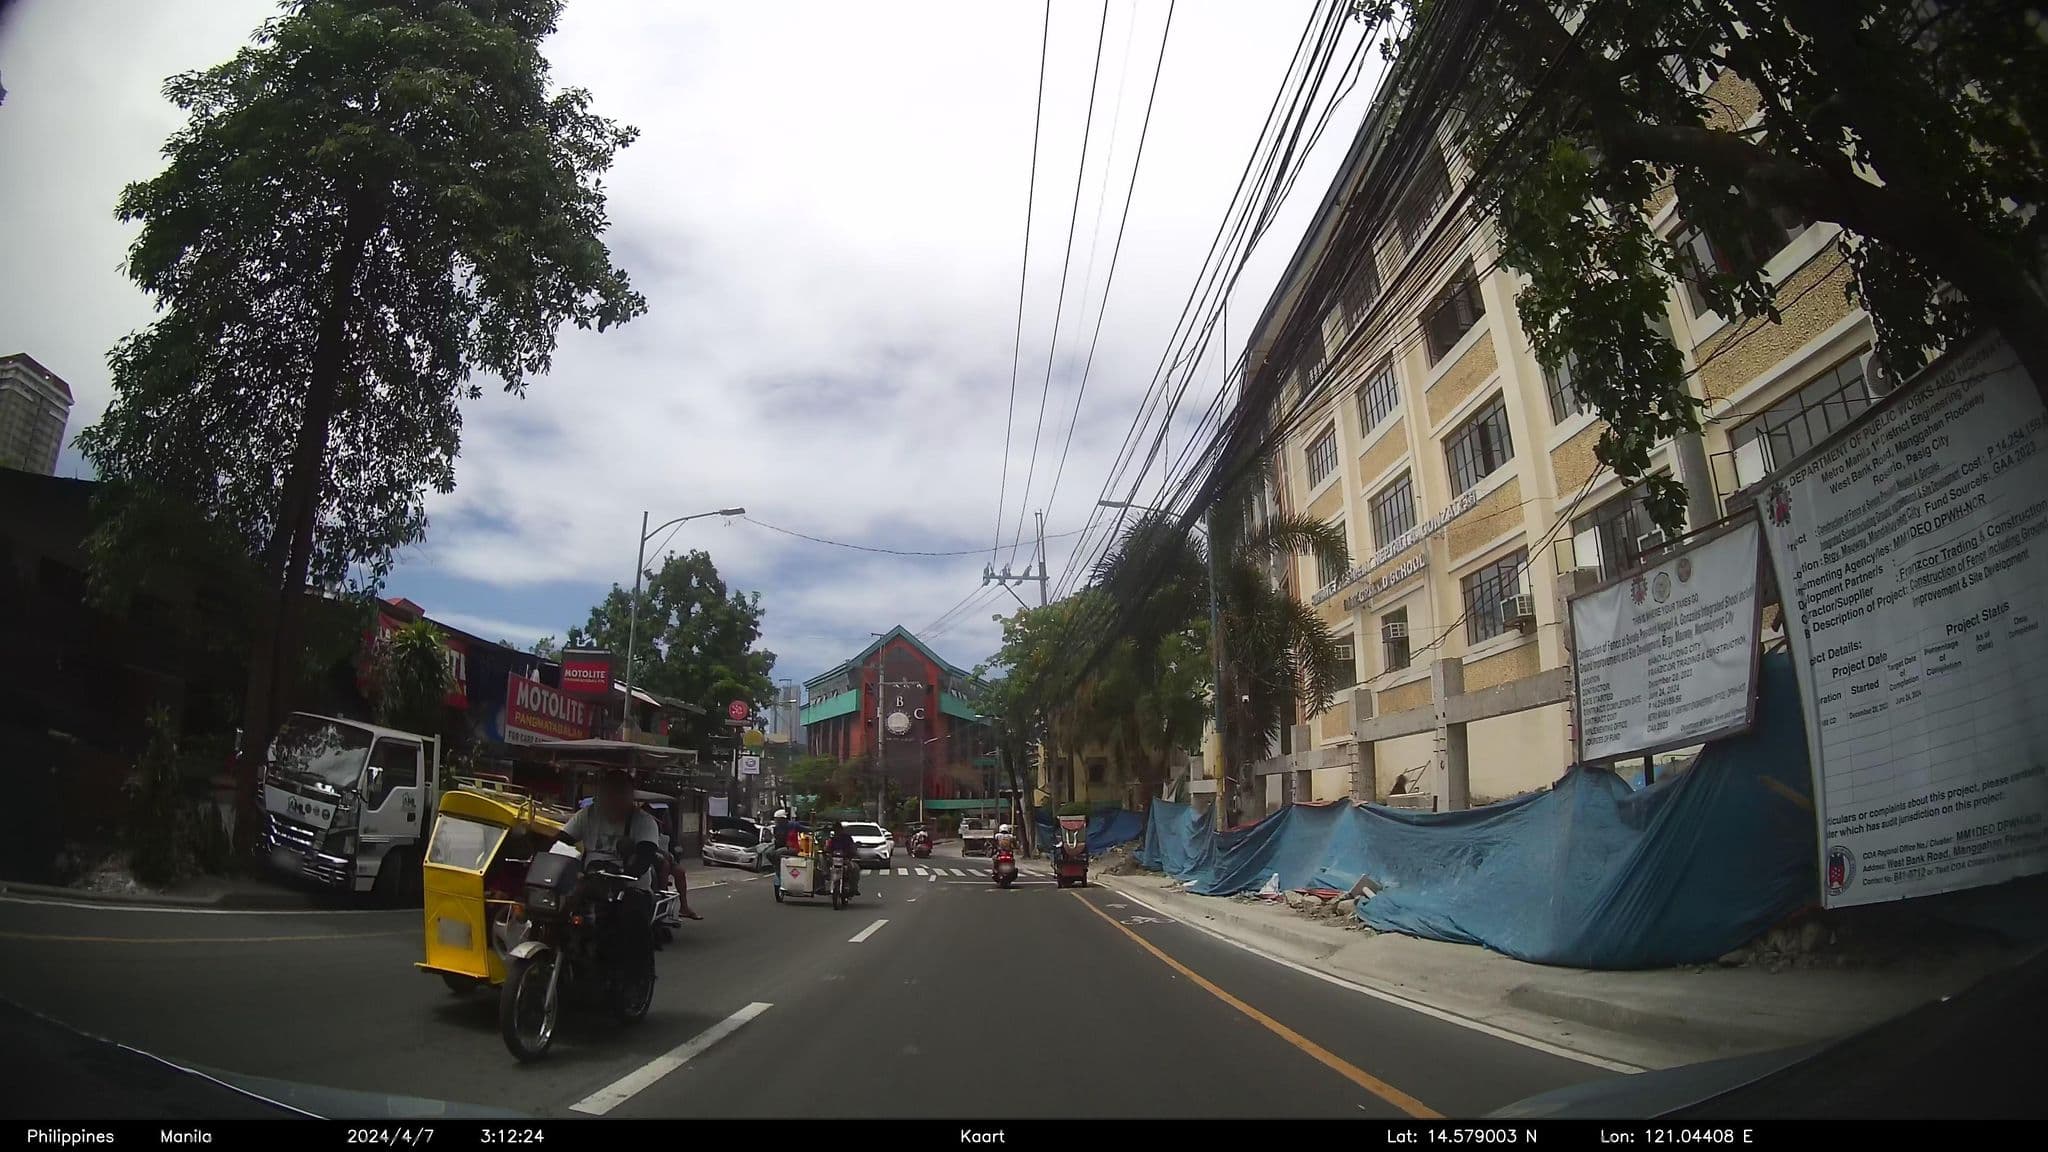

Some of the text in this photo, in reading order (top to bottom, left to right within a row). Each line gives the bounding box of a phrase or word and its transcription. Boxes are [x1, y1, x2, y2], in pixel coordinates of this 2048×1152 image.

[1789, 447, 1848, 487] DEPARTMENT
[1849, 433, 1862, 449] OF
[1863, 410, 1897, 440] PUBLIC
[1829, 475, 1850, 494] West
[1851, 463, 1872, 483] Bank
[1895, 419, 1944, 453] Manggahan
[1945, 393, 1984, 422] Floodway
[1905, 445, 1931, 465] Pasig
[1932, 434, 1949, 450] City
[1821, 464, 1844, 483] Metro
[1925, 492, 1947, 513] Fund
[1992, 453, 2014, 474] GAA
[1934, 492, 1986, 530] DPWH-NCR
[1939, 536, 1977, 560] Trading
[1987, 499, 2047, 537] Construction
[1961, 576, 1967, 589] &
[1812, 603, 1864, 632] Description
[1866, 599, 1875, 613] of
[1876, 585, 1908, 608] Project:
[1909, 564, 1954, 590] Construction
[1945, 601, 2009, 636] Project Status
[1827, 640, 1862, 660] Details:
[1831, 658, 1865, 679] Project
[1867, 651, 1888, 667] Date
[564, 669, 606, 679] MOTOLITE
[516, 680, 585, 726] MOTOLITE
[896, 696, 904, 707] B
[1815, 678, 1880, 707] ration Started
[914, 707, 925, 720] C
[1839, 823, 1864, 837] which
[1865, 821, 1880, 832] has
[1941, 804, 1953, 814] on
[1955, 799, 1971, 811] this
[1858, 810, 1868, 820] or
[1907, 794, 1928, 808] about
[1929, 790, 1945, 802] this
[1905, 853, 1924, 865] Bank
